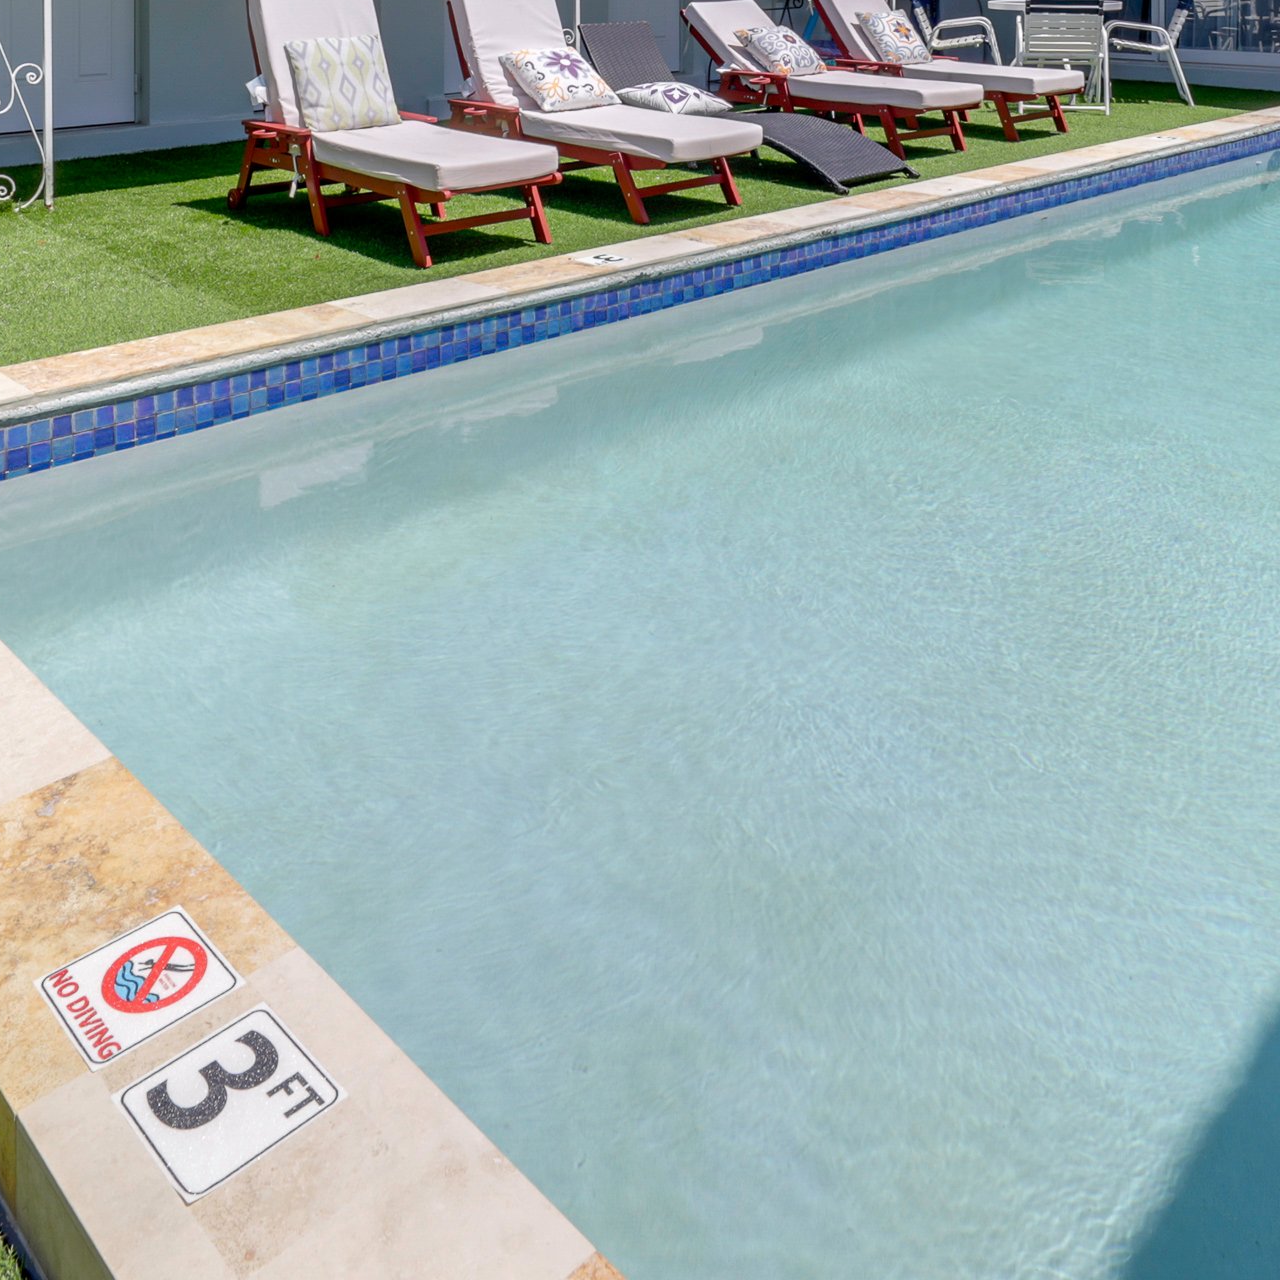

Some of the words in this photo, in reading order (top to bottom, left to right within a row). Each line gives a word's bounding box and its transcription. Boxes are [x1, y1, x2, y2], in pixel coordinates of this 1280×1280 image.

[48, 969, 80, 999] NO
[65, 995, 123, 1061] DIVING
[145, 1029, 280, 1131] 3
[266, 1071, 326, 1119] FT
